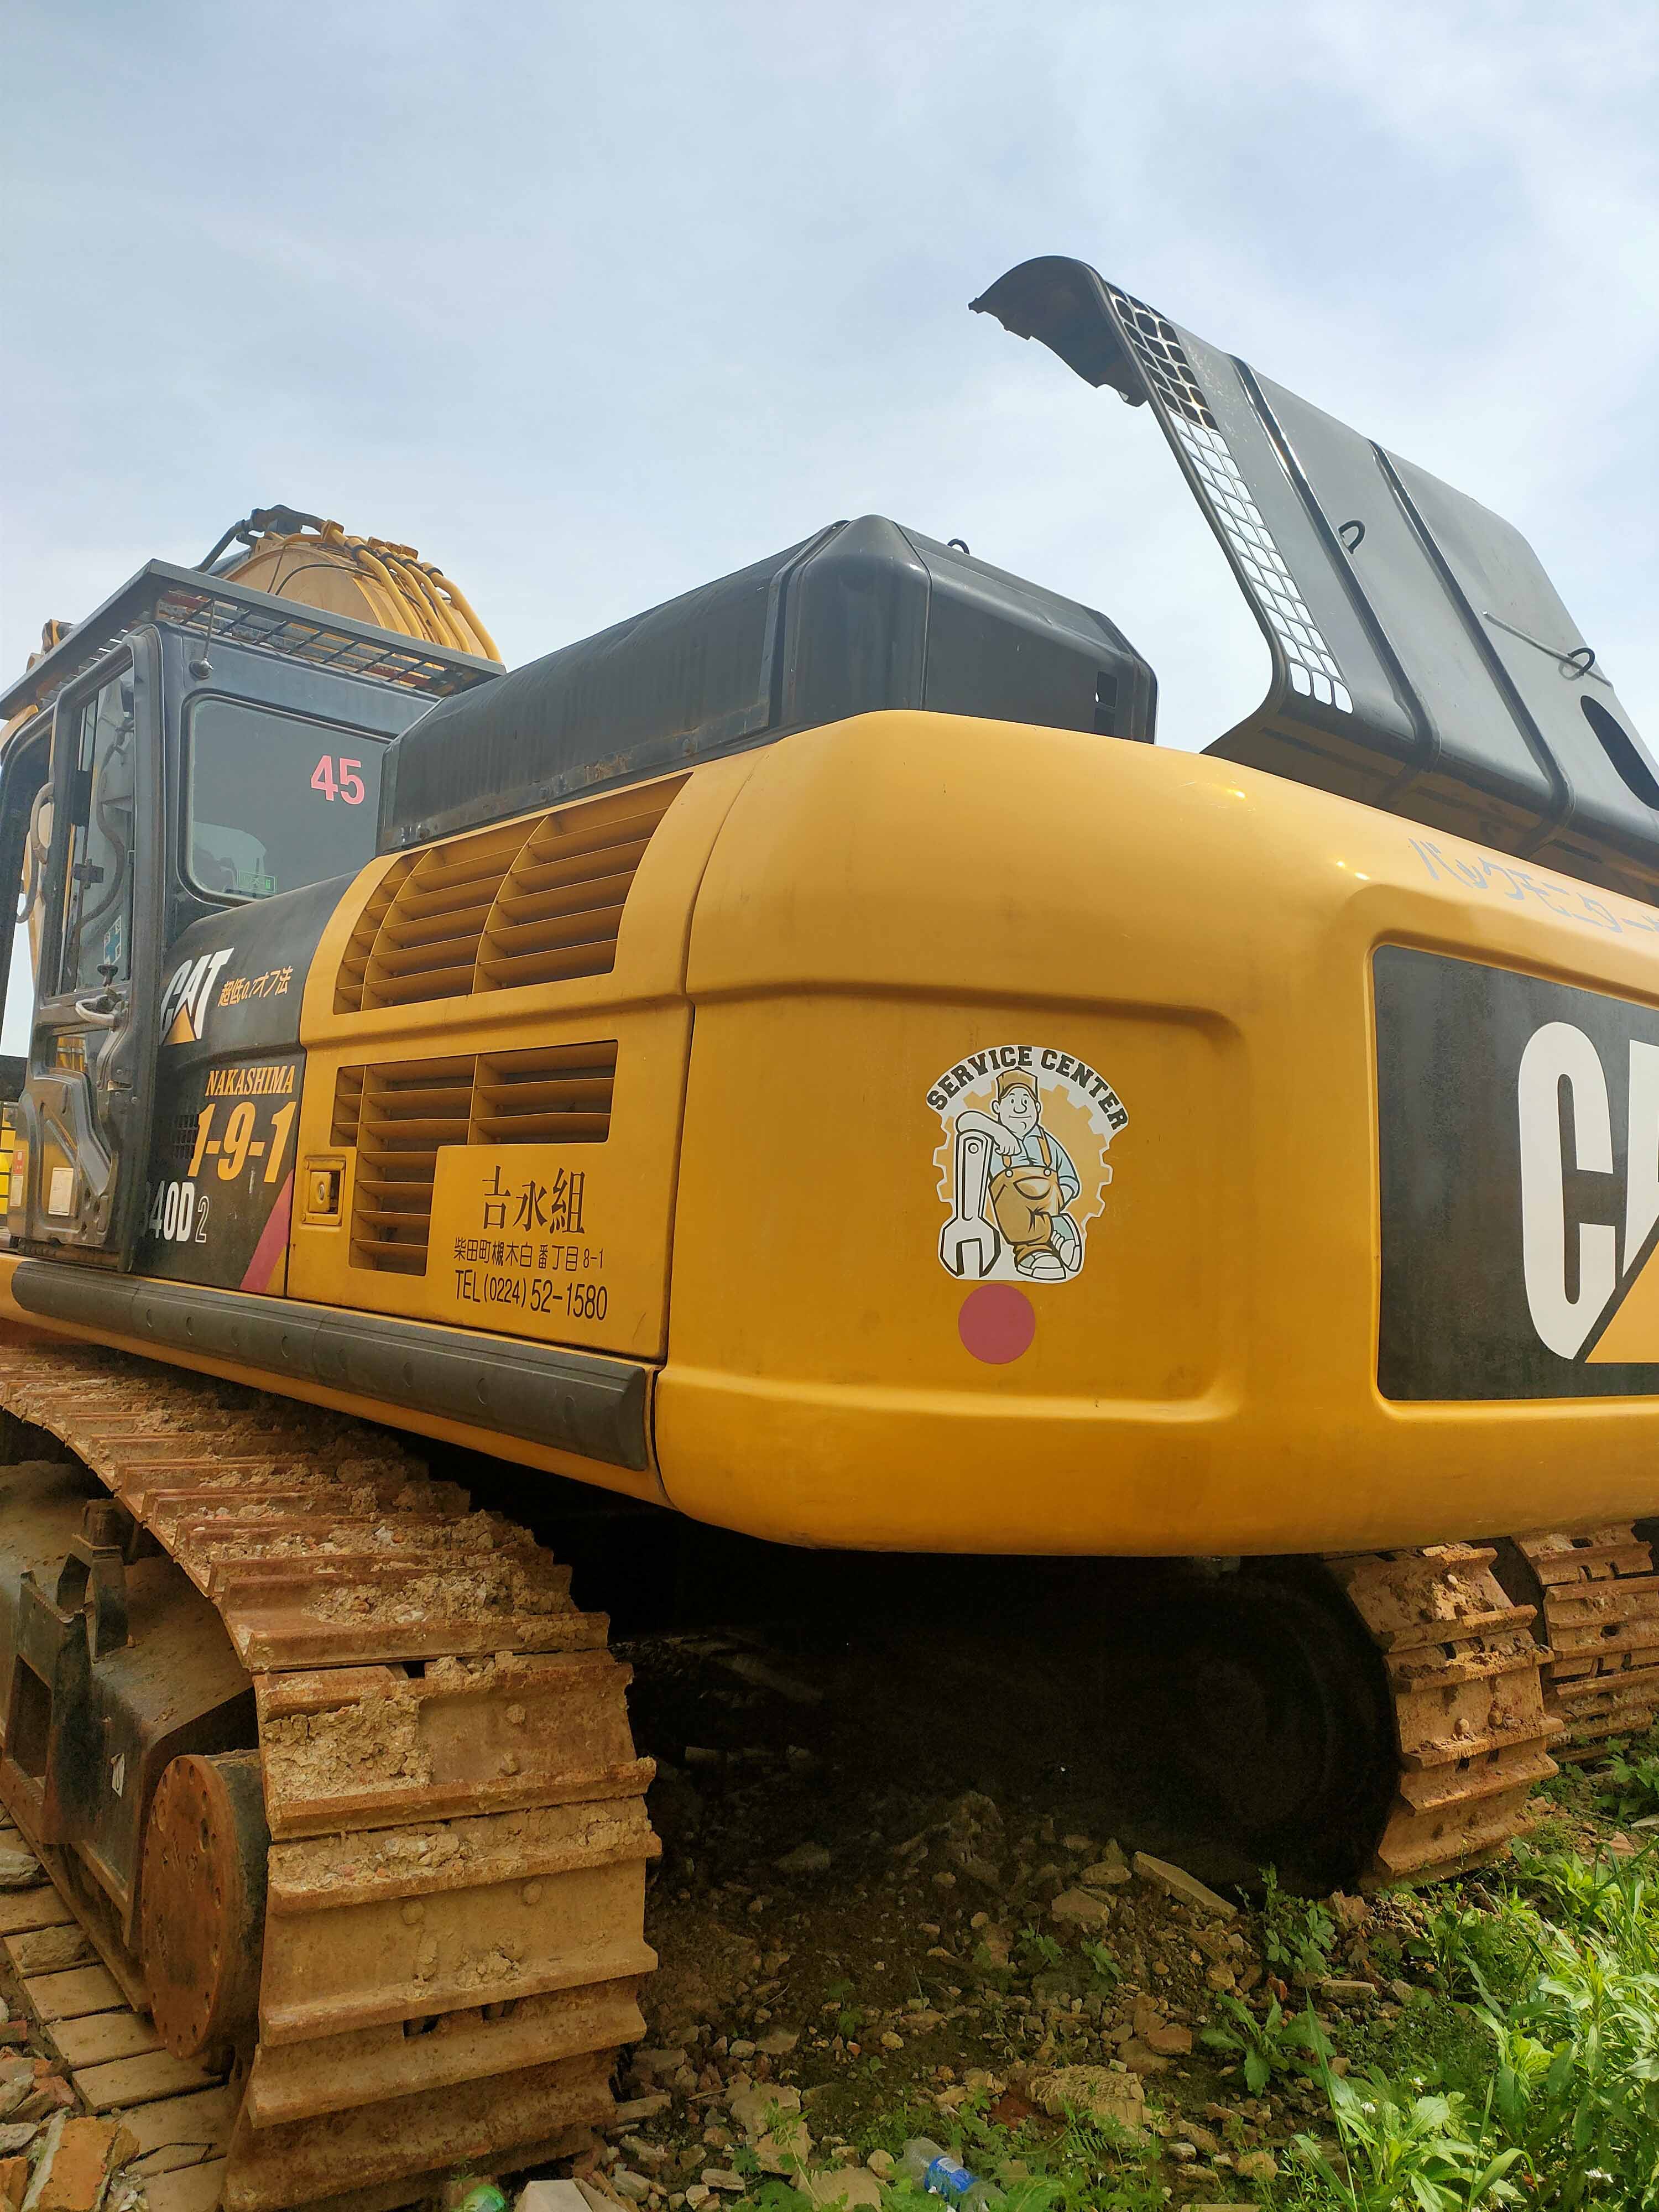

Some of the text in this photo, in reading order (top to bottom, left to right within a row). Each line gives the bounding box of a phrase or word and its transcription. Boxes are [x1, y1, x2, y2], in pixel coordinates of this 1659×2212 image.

[311, 755, 365, 805] 45
[1408, 837, 1658, 933] バックモニター
[159, 947, 234, 1045] CAT
[205, 1065, 296, 1096] NAKASHIMA
[927, 1046, 1129, 1130] SERVICE CENTER
[187, 1101, 297, 1183] 1-9-1
